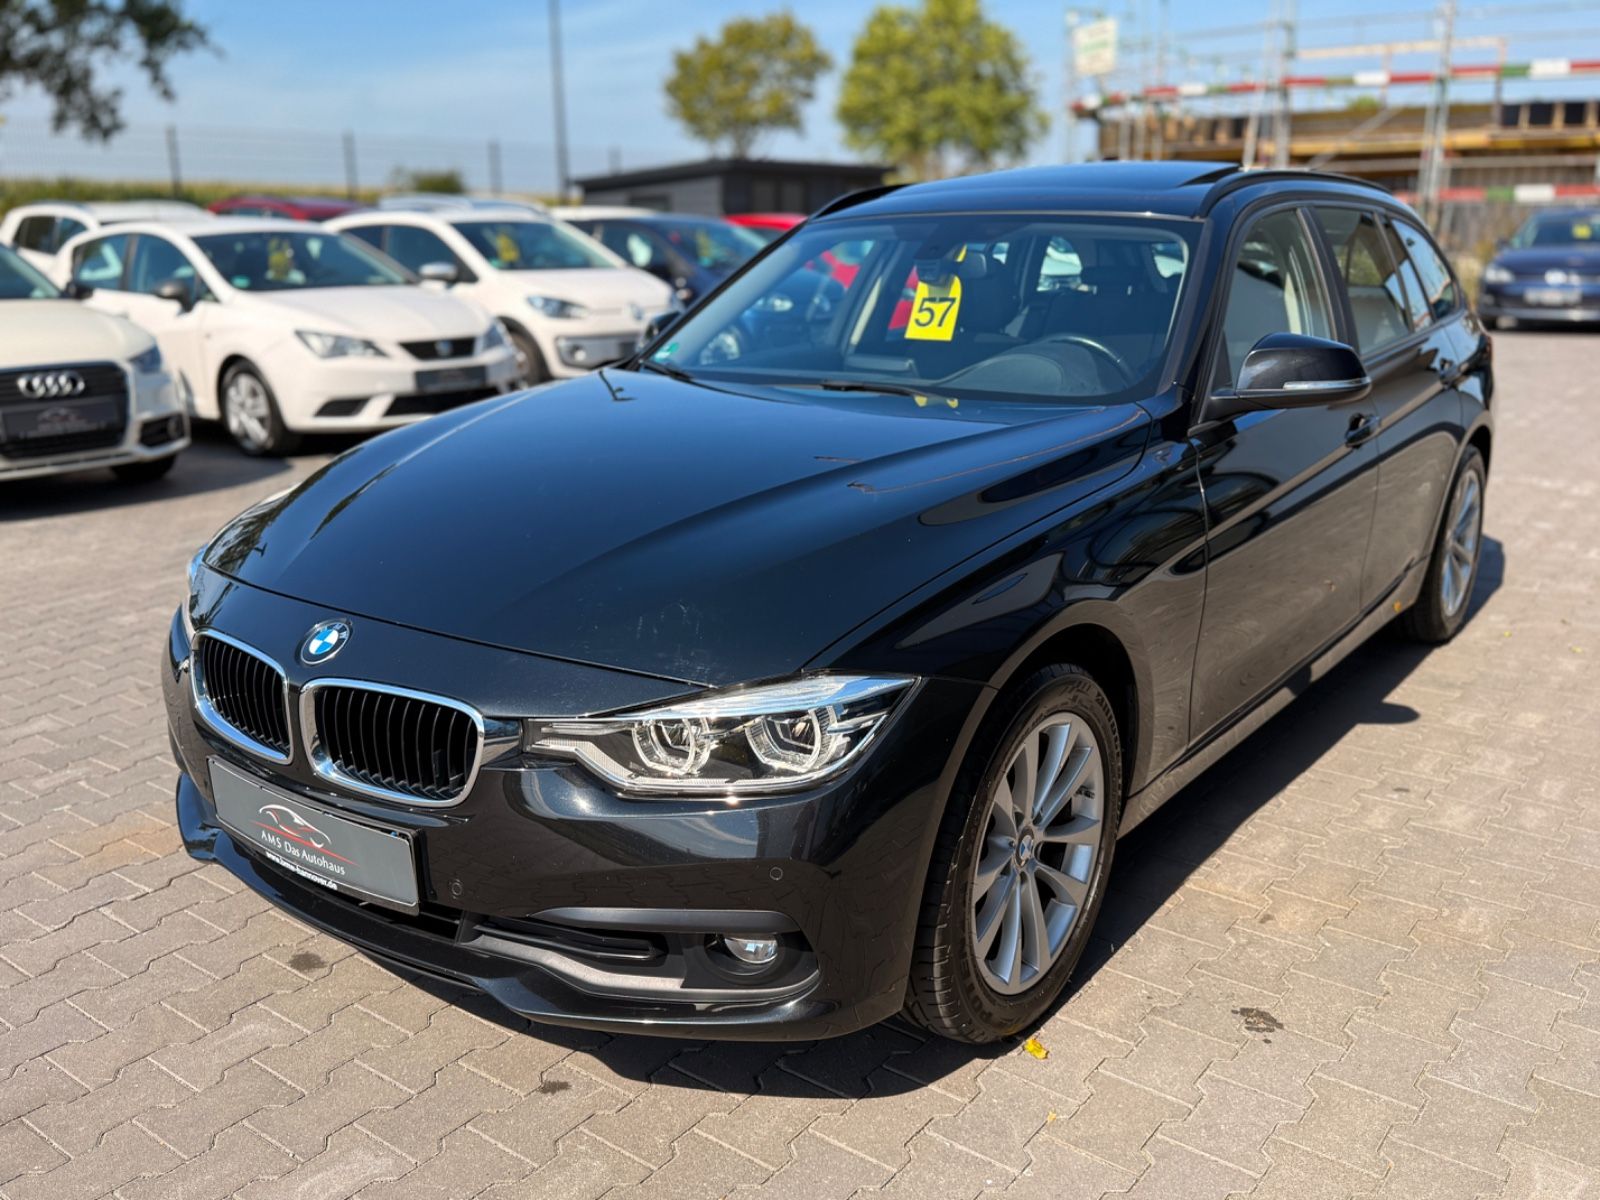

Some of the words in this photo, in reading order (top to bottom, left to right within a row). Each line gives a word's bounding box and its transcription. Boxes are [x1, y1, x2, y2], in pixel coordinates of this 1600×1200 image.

[914, 297, 957, 327] 57
[284, 841, 300, 857] Das
[301, 849, 346, 876] Autohaus
